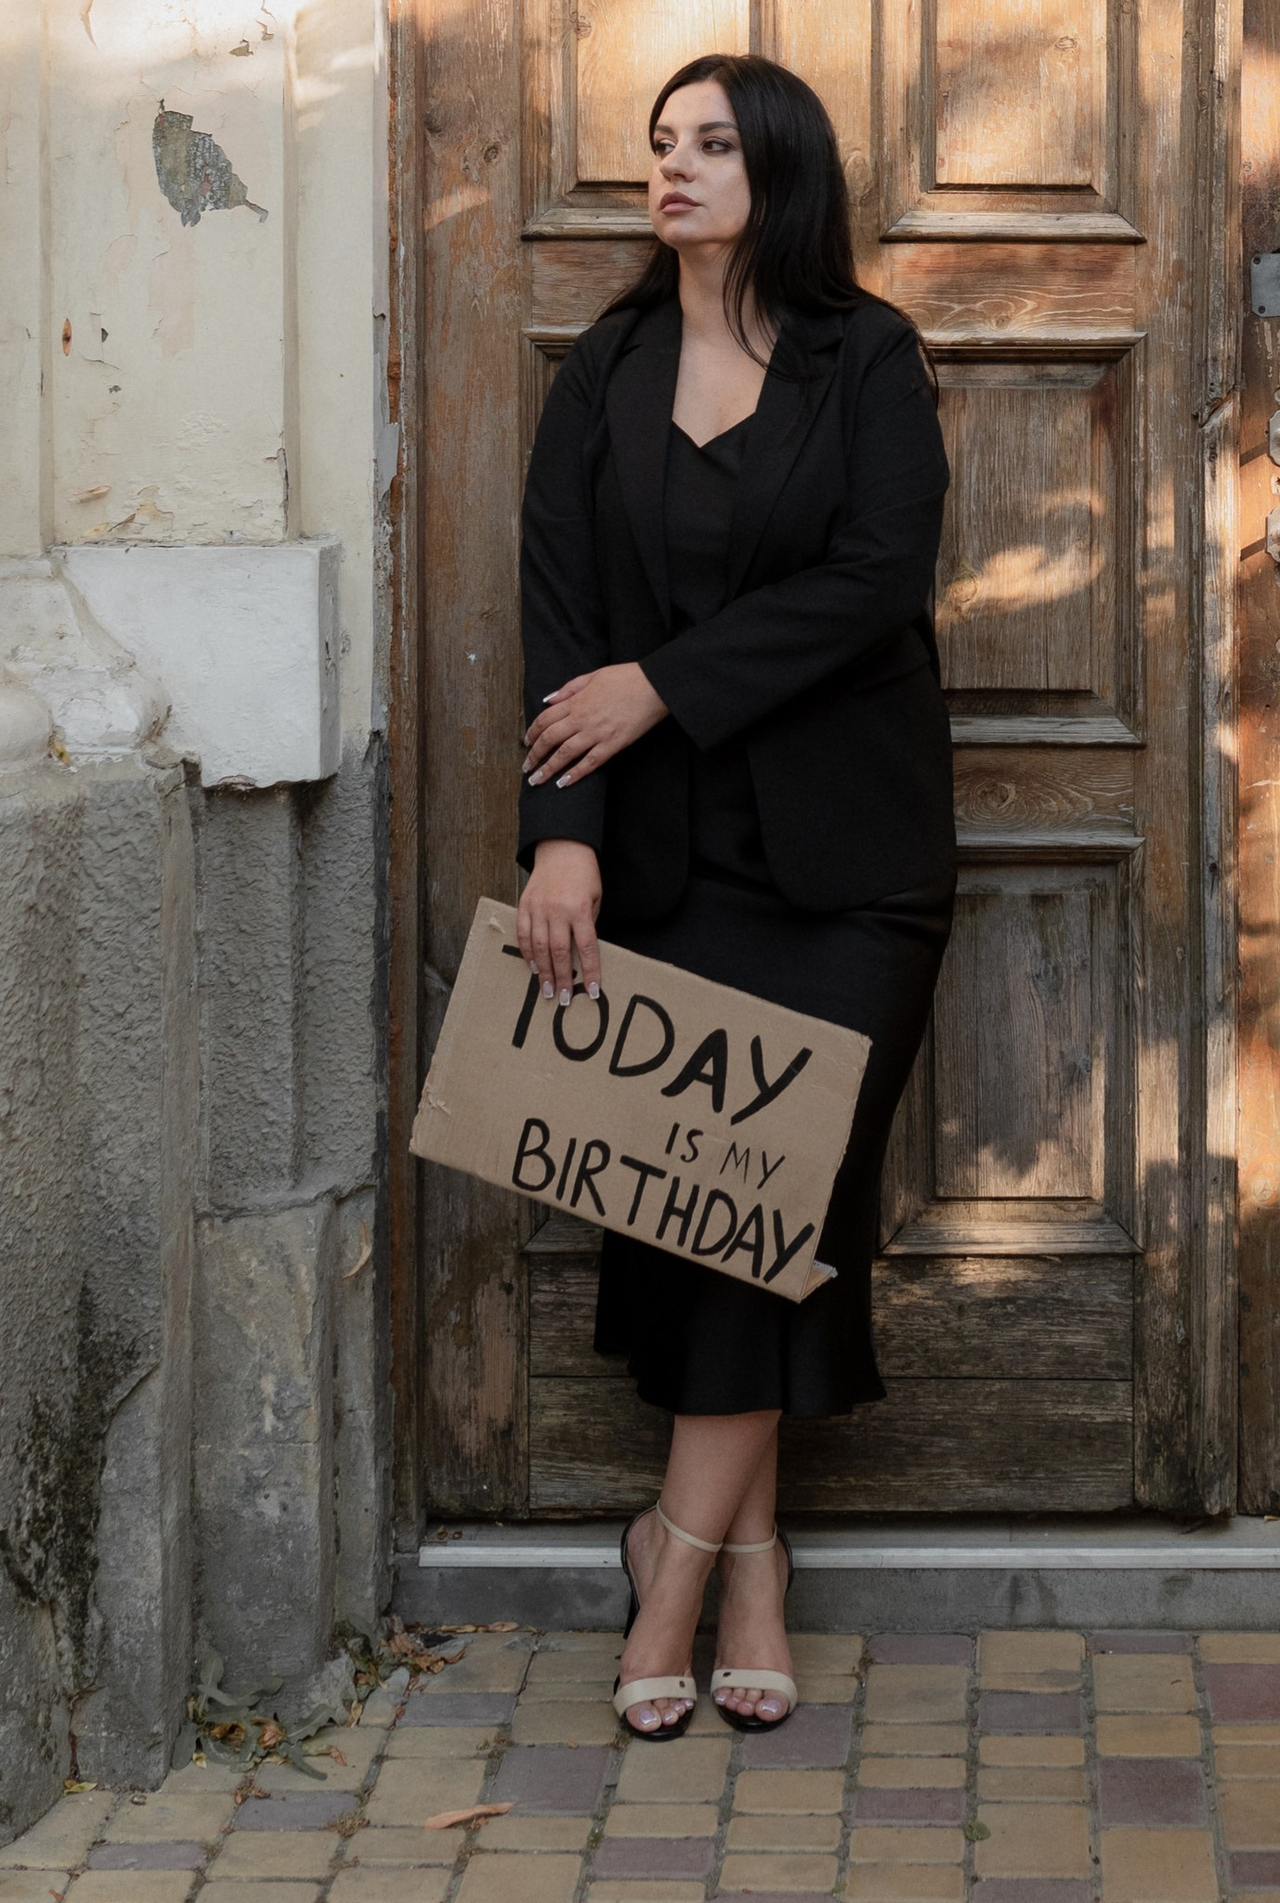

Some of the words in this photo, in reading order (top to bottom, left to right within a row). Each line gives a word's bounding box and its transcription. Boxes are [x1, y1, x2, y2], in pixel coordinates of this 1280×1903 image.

[502, 944, 813, 1126] TODAY
[511, 1117, 815, 1285] BIRTHDAY
[664, 1122, 704, 1163] IS
[719, 1141, 786, 1190] MY
